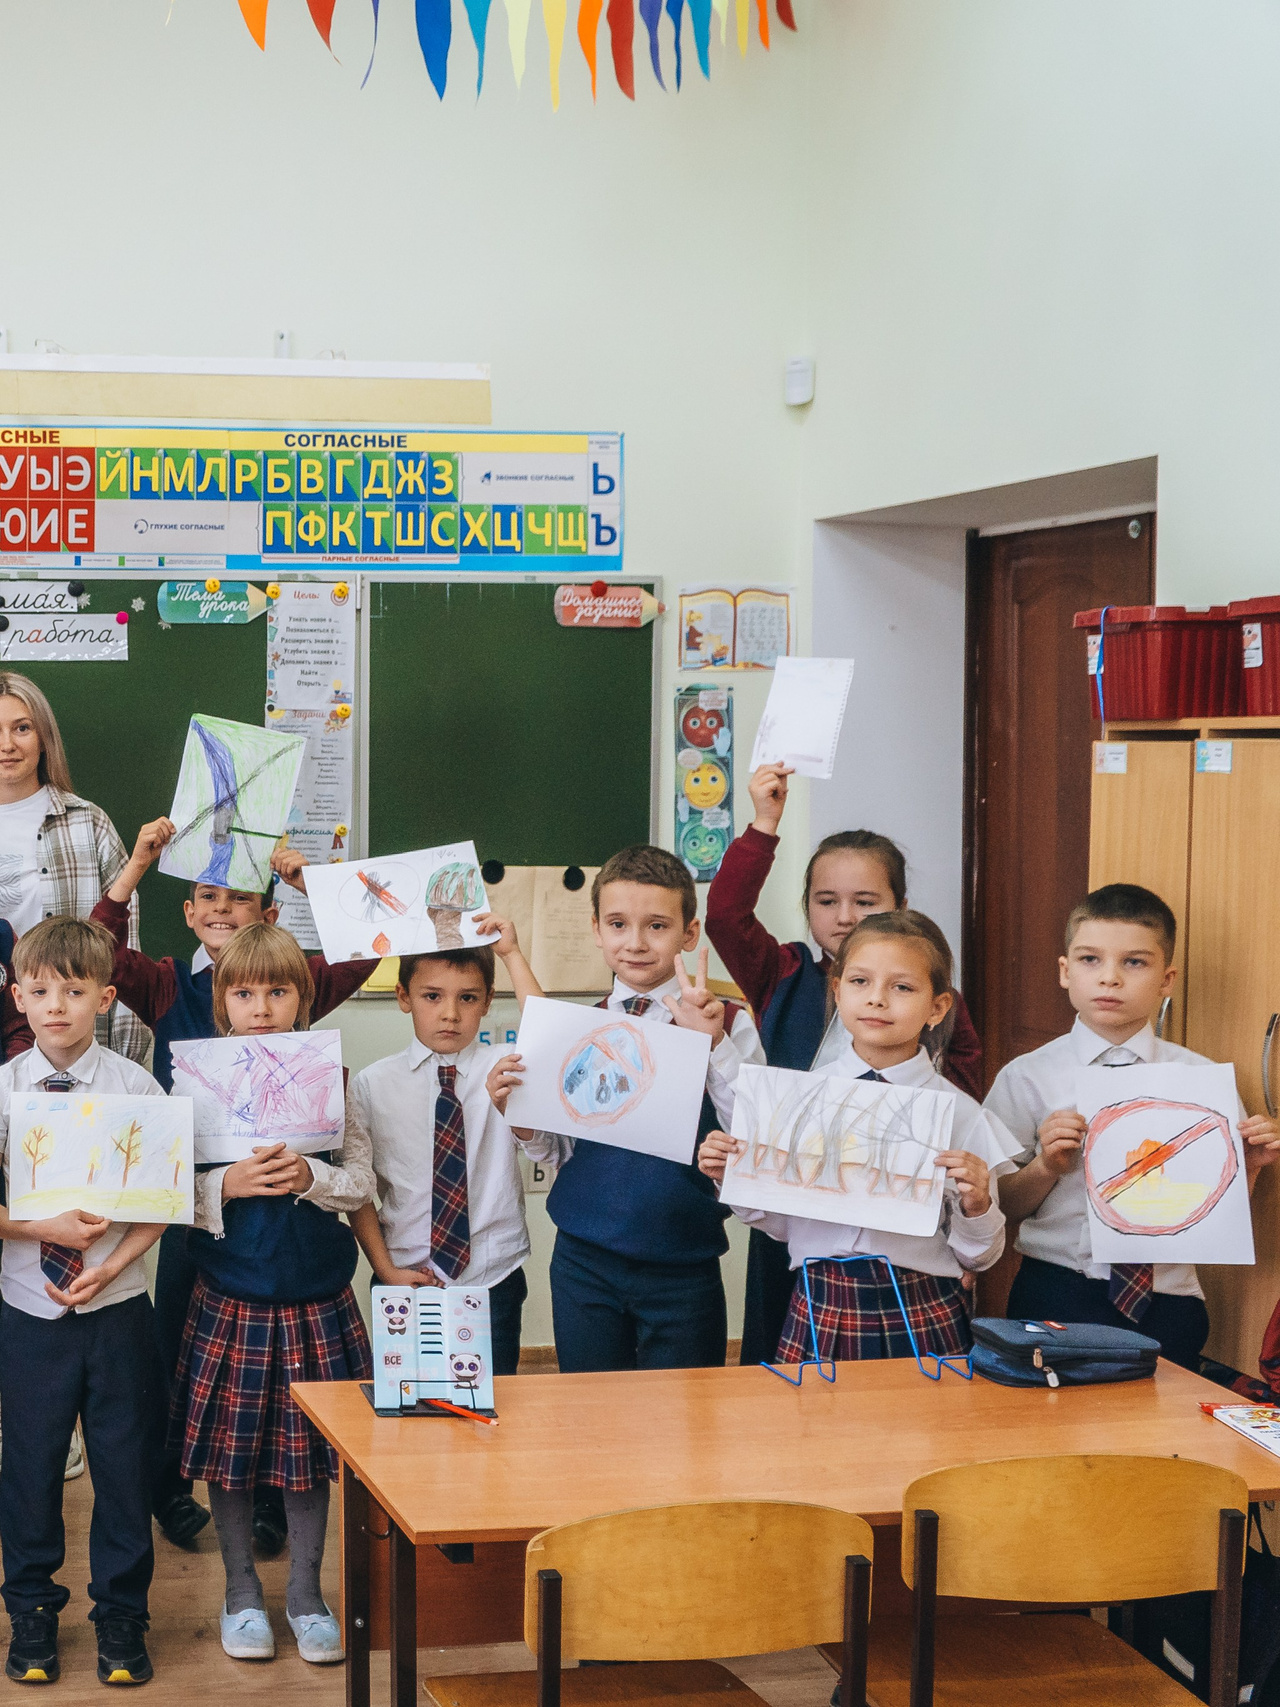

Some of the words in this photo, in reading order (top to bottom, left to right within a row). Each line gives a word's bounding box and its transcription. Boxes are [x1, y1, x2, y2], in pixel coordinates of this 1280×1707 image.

[284, 433, 408, 449] СОГЛАСНЫЕ
[150, 523, 178, 531] ГЛУХИЕ
[180, 523, 225, 531] СОГЛАСНЫЕ
[321, 555, 353, 563] ПАРНЫЕ
[354, 555, 401, 563] СОГЛАСНЫЕ
[171, 582, 226, 602] Тема
[199, 598, 251, 618] урока
[574, 602, 642, 624] задание
[384, 1355, 402, 1366] ВСЕ
